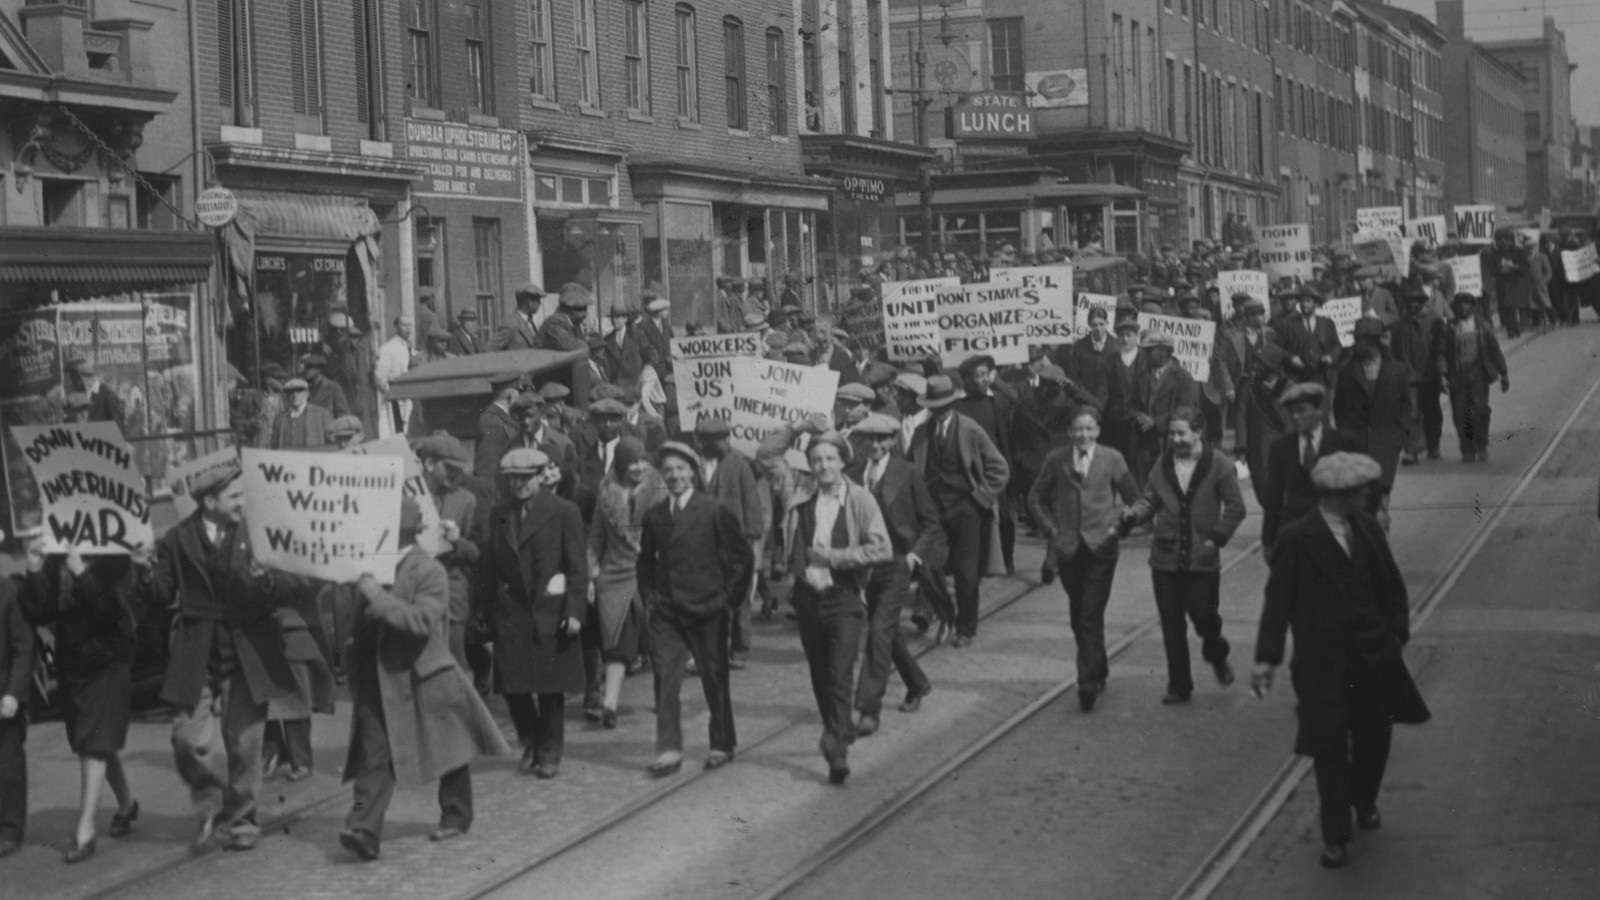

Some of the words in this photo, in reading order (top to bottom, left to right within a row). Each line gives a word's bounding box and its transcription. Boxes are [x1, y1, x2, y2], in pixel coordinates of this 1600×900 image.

[973, 96, 1017, 108] STATE
[961, 112, 1030, 132] LUNCH
[408, 123, 444, 144] DUNBAR
[844, 177, 885, 195] OPTIMO
[197, 202, 233, 213] BILLIARDS
[1262, 228, 1299, 238] FIGHT
[256, 257, 286, 271] LUNCHES
[887, 299, 936, 317] UNIT
[939, 309, 1024, 330] ORGANIZE
[1149, 317, 1202, 338] DEMAND
[1026, 322, 1071, 338] OSSES
[678, 337, 757, 355] WORKERS
[945, 333, 1024, 352] FIGHT
[692, 361, 732, 379] JOIN
[760, 365, 803, 387] JOIN
[694, 379, 723, 398] US
[696, 407, 733, 425] MAR
[733, 396, 812, 423] UNEMPLOY
[731, 424, 769, 443] COU
[25, 428, 75, 464] DOWN
[76, 430, 130, 470] WITH
[258, 463, 295, 484] We
[309, 466, 396, 490] Demand
[287, 490, 360, 515] Work
[48, 508, 144, 551] WAR
